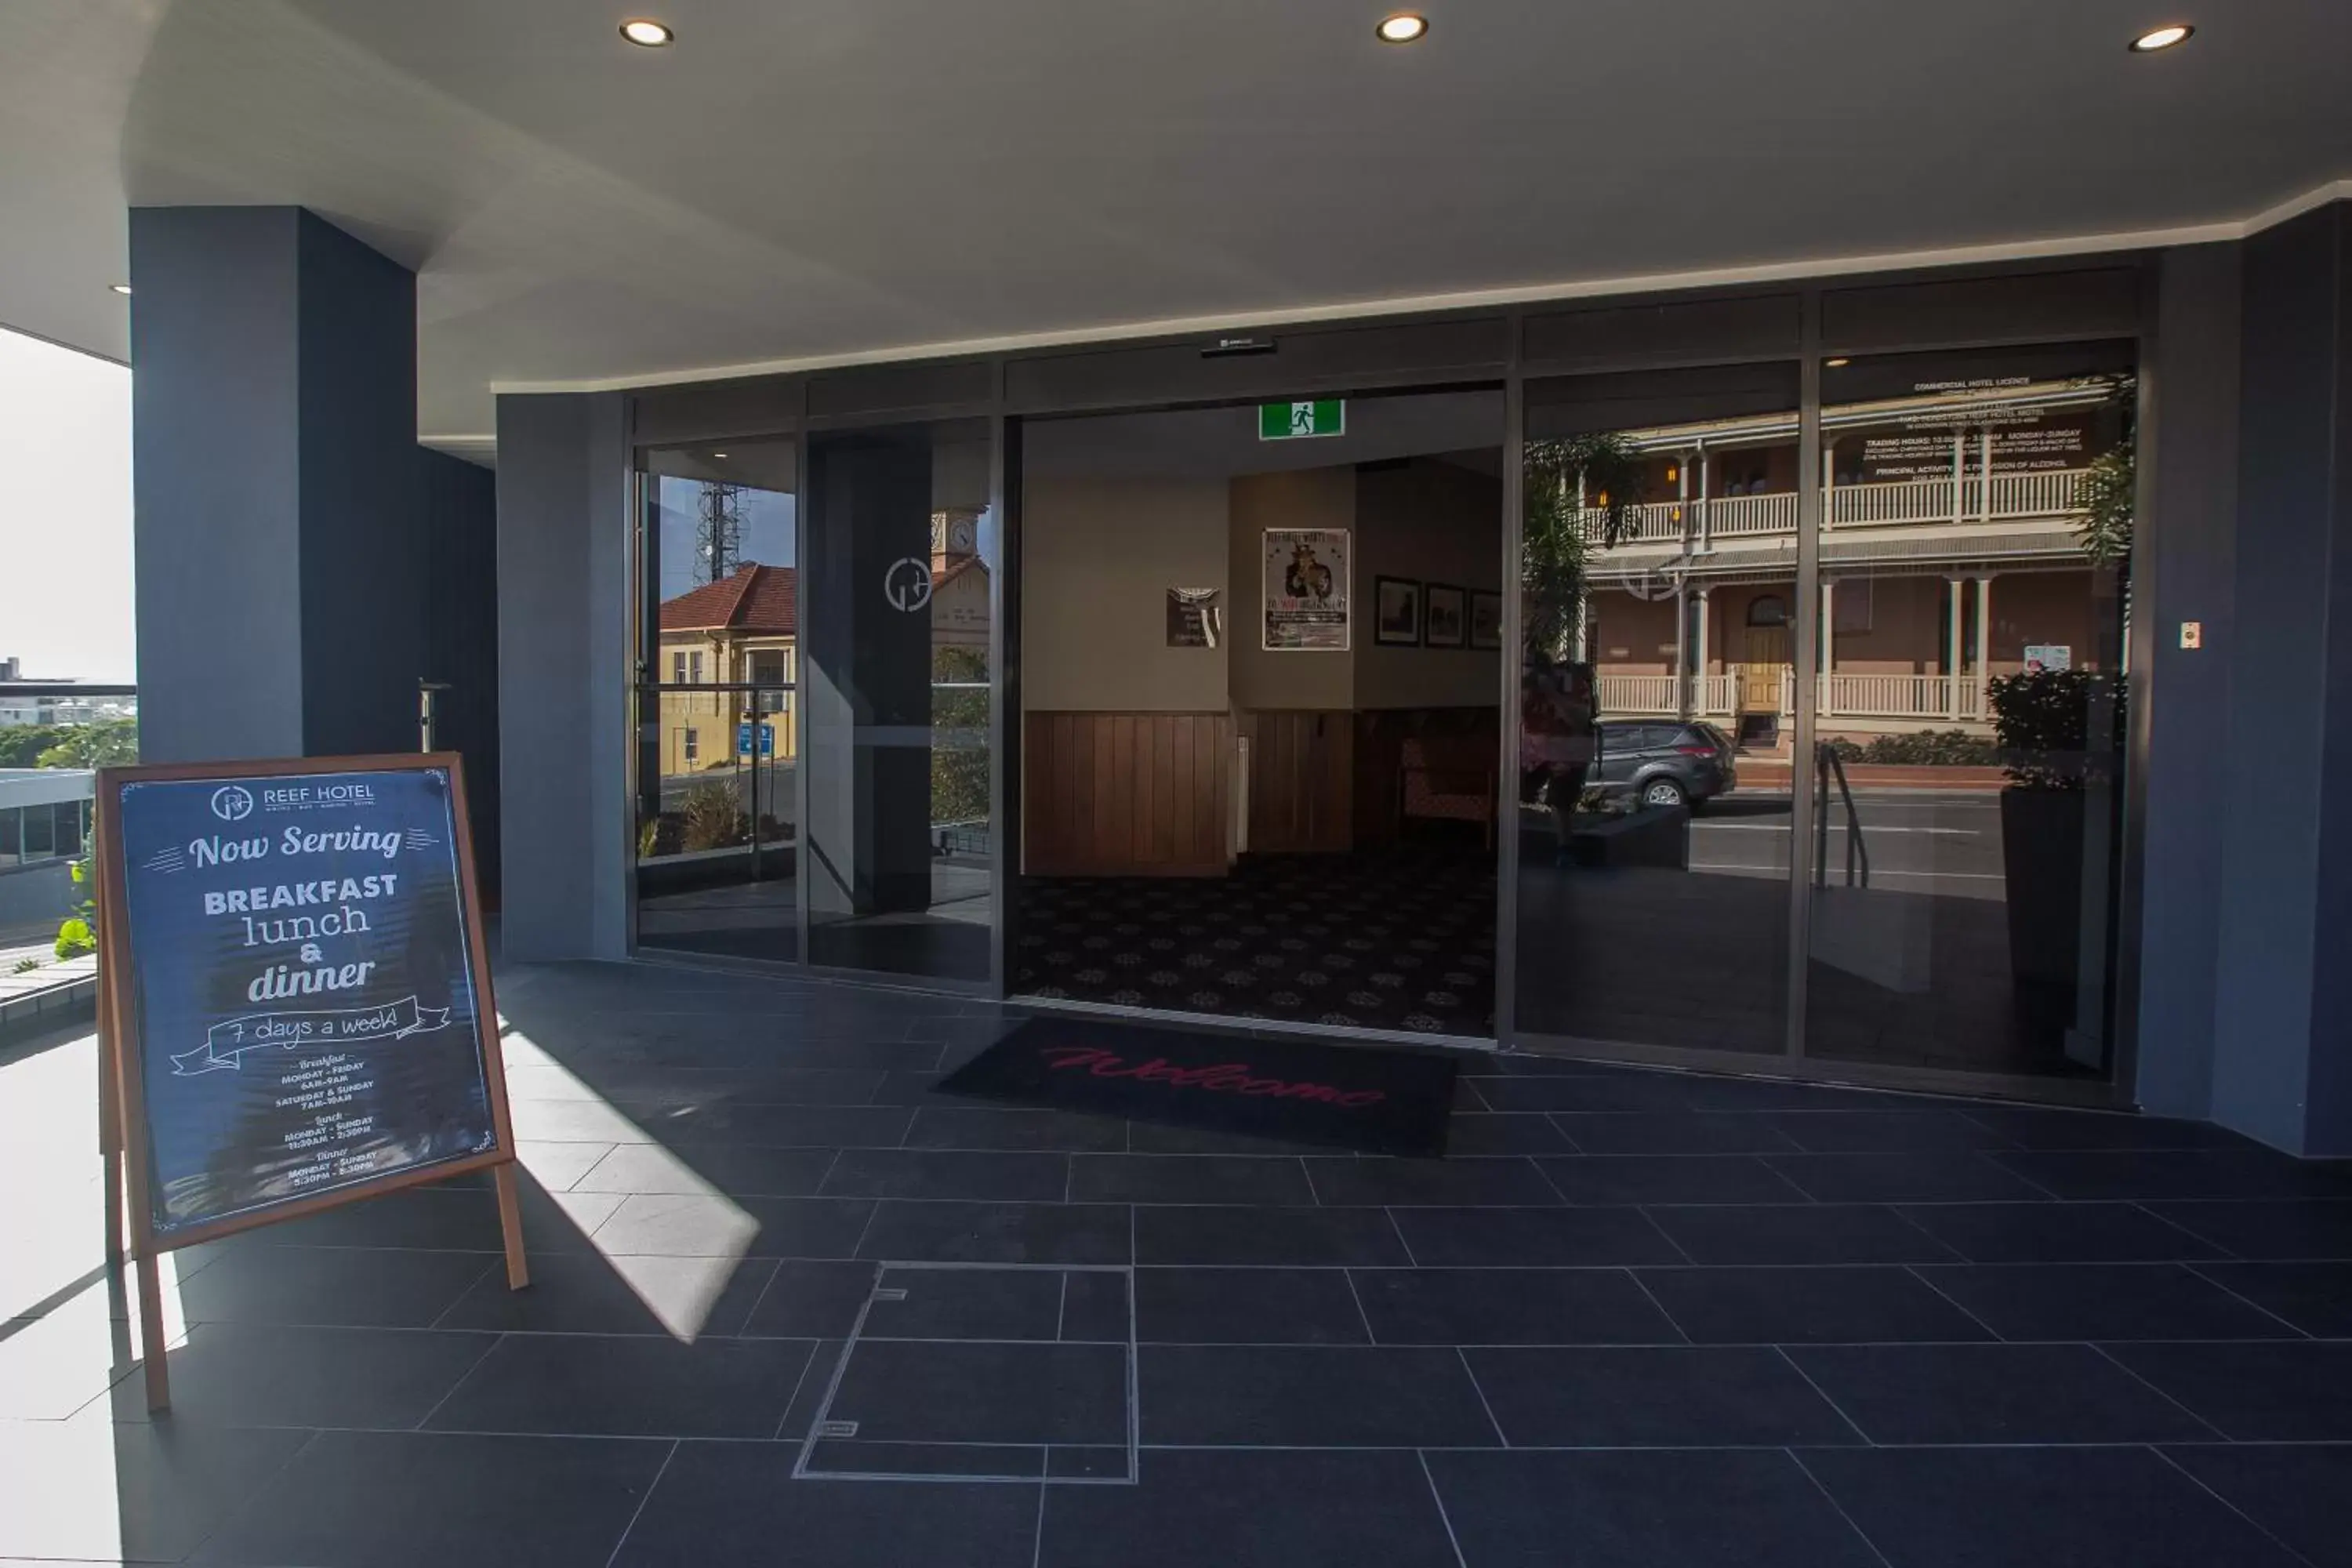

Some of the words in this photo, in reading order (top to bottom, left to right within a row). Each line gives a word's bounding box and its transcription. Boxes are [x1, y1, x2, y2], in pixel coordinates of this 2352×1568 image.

[1969, 379, 1994, 387] HOTEL
[1866, 438, 1900, 448] TRADING
[263, 788, 309, 803] REEF
[318, 785, 374, 800] HOTEL
[189, 835, 269, 868] Now
[280, 824, 401, 858] Serving
[204, 873, 397, 916] BREAKFAST
[241, 905, 371, 946] lunch
[299, 942, 323, 964] &
[248, 960, 376, 1002] dinner
[232, 1023, 245, 1043] 7
[255, 1017, 313, 1048] days
[321, 1022, 335, 1034] a
[281, 1069, 323, 1084] MONDAY
[332, 1062, 365, 1075] FRIDAY
[1040, 1047, 1387, 1106] Welcome
[275, 1091, 325, 1108] SATURDAY
[327, 1088, 335, 1097] &
[337, 1080, 374, 1094] SUNDAY
[285, 1127, 327, 1142] MONDAY
[336, 1116, 373, 1131] SUNDAY
[288, 1163, 330, 1179] MONDAY
[339, 1151, 377, 1166] SUNDAY
